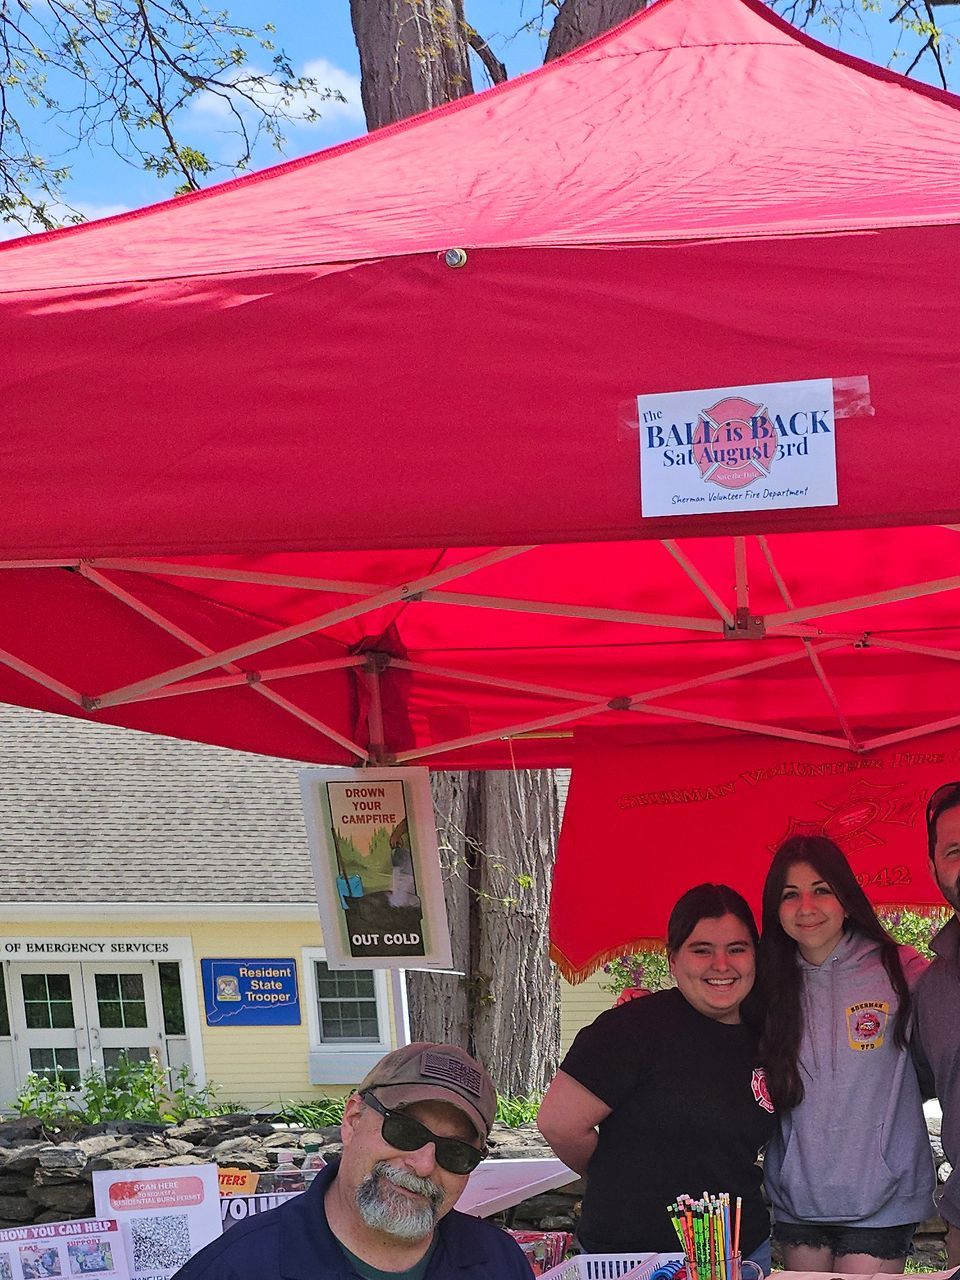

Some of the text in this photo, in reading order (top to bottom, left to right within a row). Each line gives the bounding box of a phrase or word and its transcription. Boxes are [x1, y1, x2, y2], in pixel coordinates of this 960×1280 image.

[643, 409, 663, 423] The
[647, 409, 832, 449] BALL is BACK
[663, 436, 809, 468] Sat August 3rd
[671, 486, 809, 505] Sherman Volunteer Fire Department
[345, 788, 385, 798] DROWN
[352, 801, 382, 811] YOUR
[341, 814, 397, 824] CAMPFIRE
[352, 933, 420, 945] OUT COLD
[5, 943, 169, 953] OF EMERGENCY SERVICES
[239, 967, 291, 978] Resident
[250, 980, 283, 990] State
[245, 991, 290, 1003] Trooper
[850, 1002, 884, 1013] SHERMAN
[133, 1181, 178, 1192] SCAN HERE
[113, 1194, 201, 1207] RESIDENTIAL BURN PERMIT
[0, 1221, 111, 1241] HOW YOU CAN HELP
[67, 1239, 101, 1247] SUPPORT
